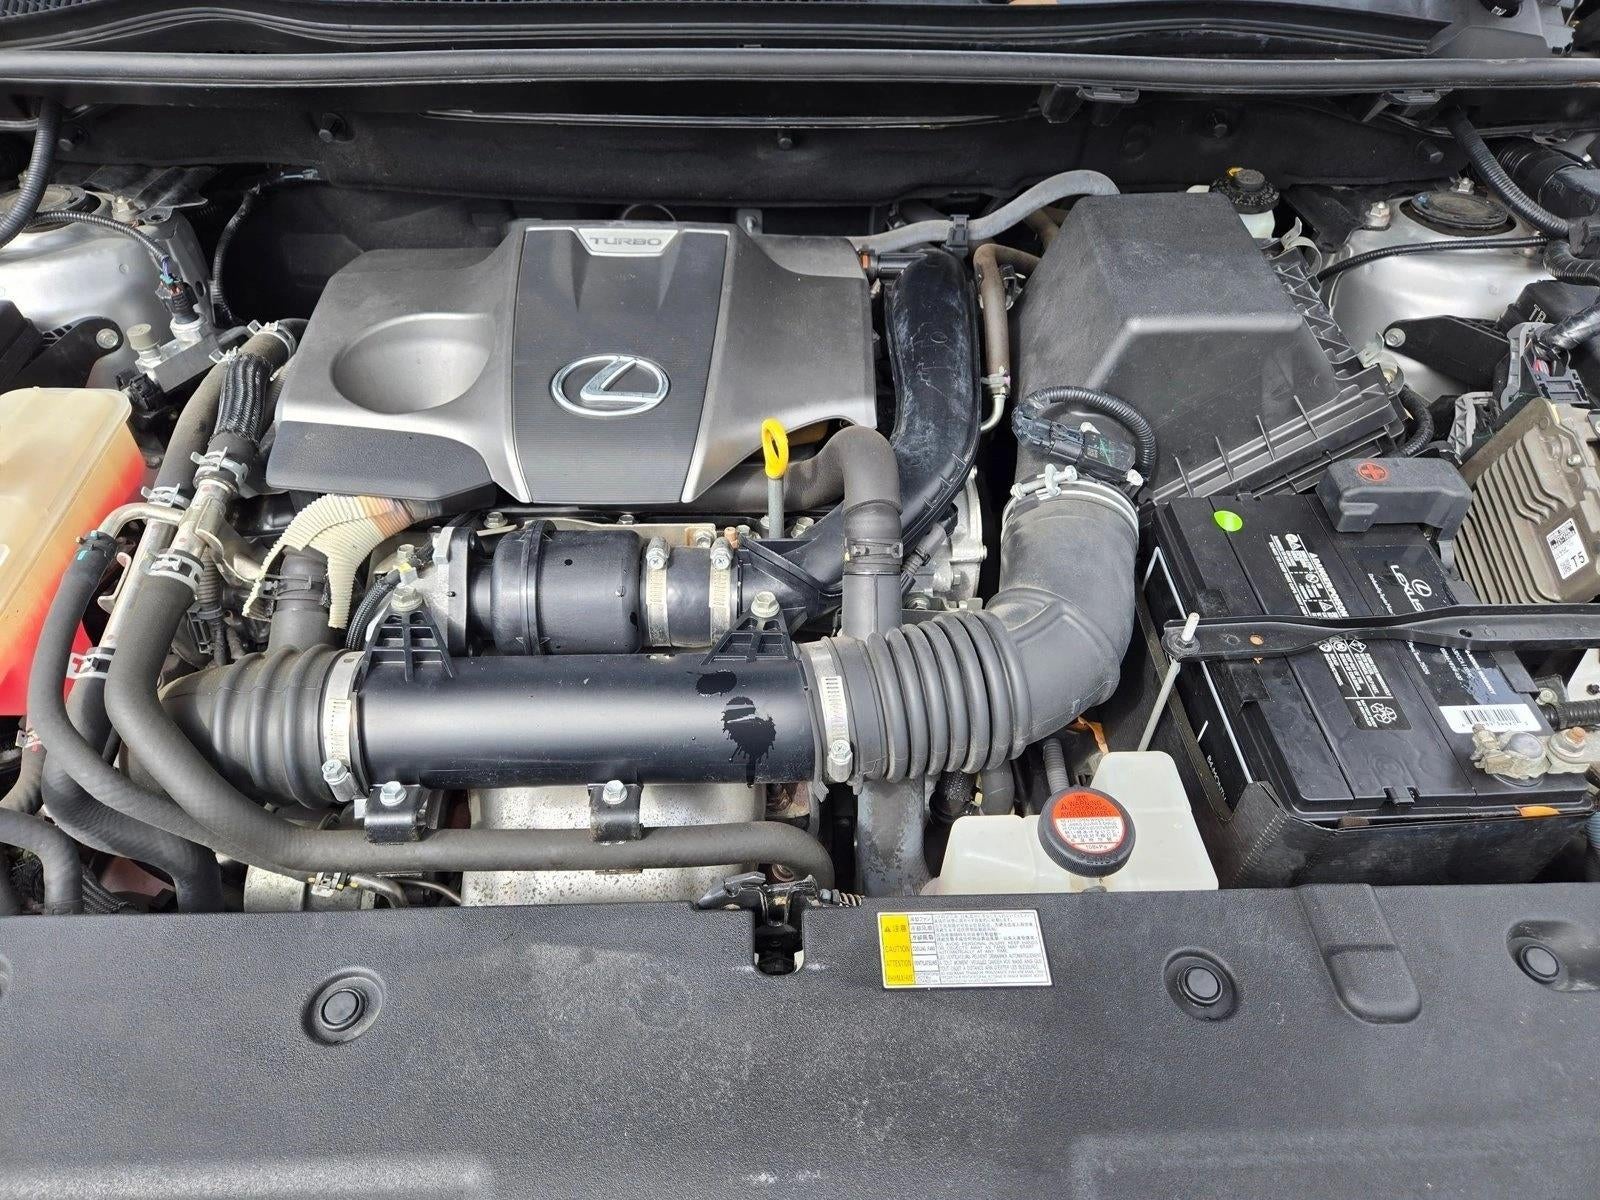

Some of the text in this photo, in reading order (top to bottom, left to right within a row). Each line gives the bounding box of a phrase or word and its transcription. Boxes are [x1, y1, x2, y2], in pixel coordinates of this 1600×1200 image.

[590, 237, 662, 246] TURBO
[1571, 552, 1585, 567] T5
[1390, 565, 1424, 611] LEXUS
